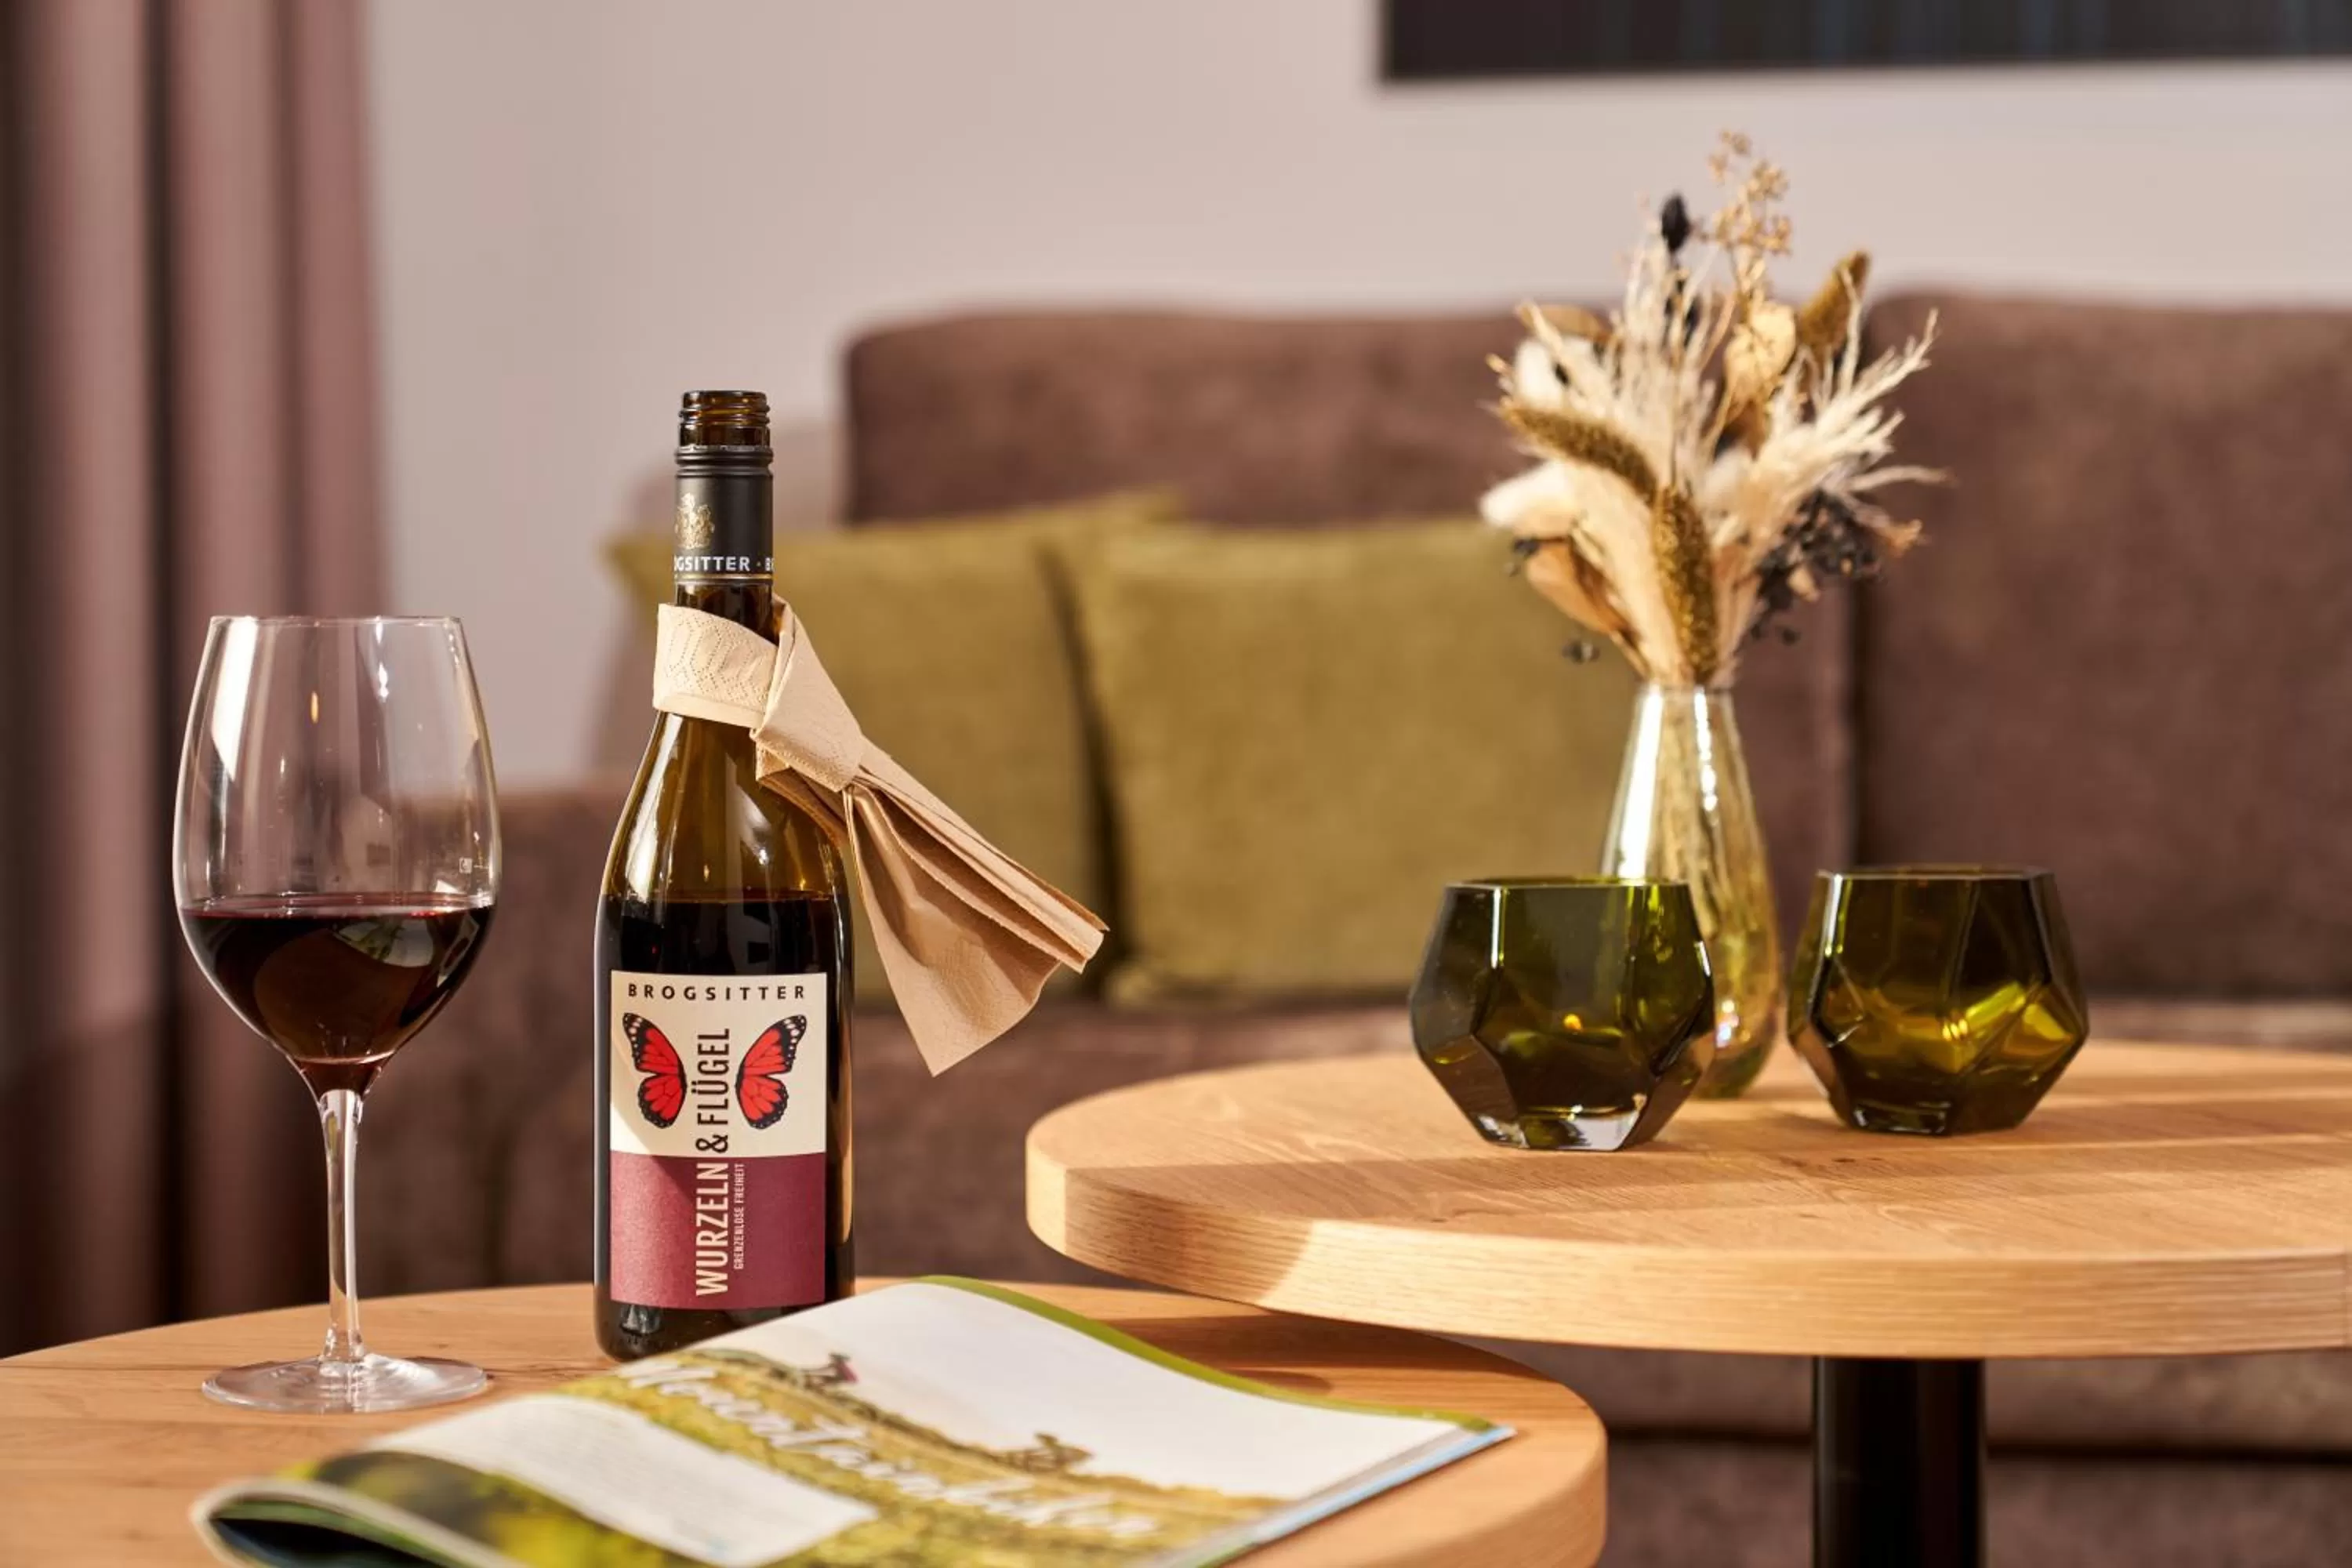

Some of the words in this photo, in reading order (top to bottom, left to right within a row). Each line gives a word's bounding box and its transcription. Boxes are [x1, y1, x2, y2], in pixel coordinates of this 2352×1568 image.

[674, 555, 750, 572] GSITTER
[628, 983, 804, 1001] BROGSITTER
[691, 1027, 730, 1127] FLÜGEL
[695, 1133, 729, 1154] &
[734, 1163, 746, 1204] FREIHEIT
[695, 1162, 728, 1297] WURZELN
[733, 1206, 745, 1270] GRENZENLOSE
